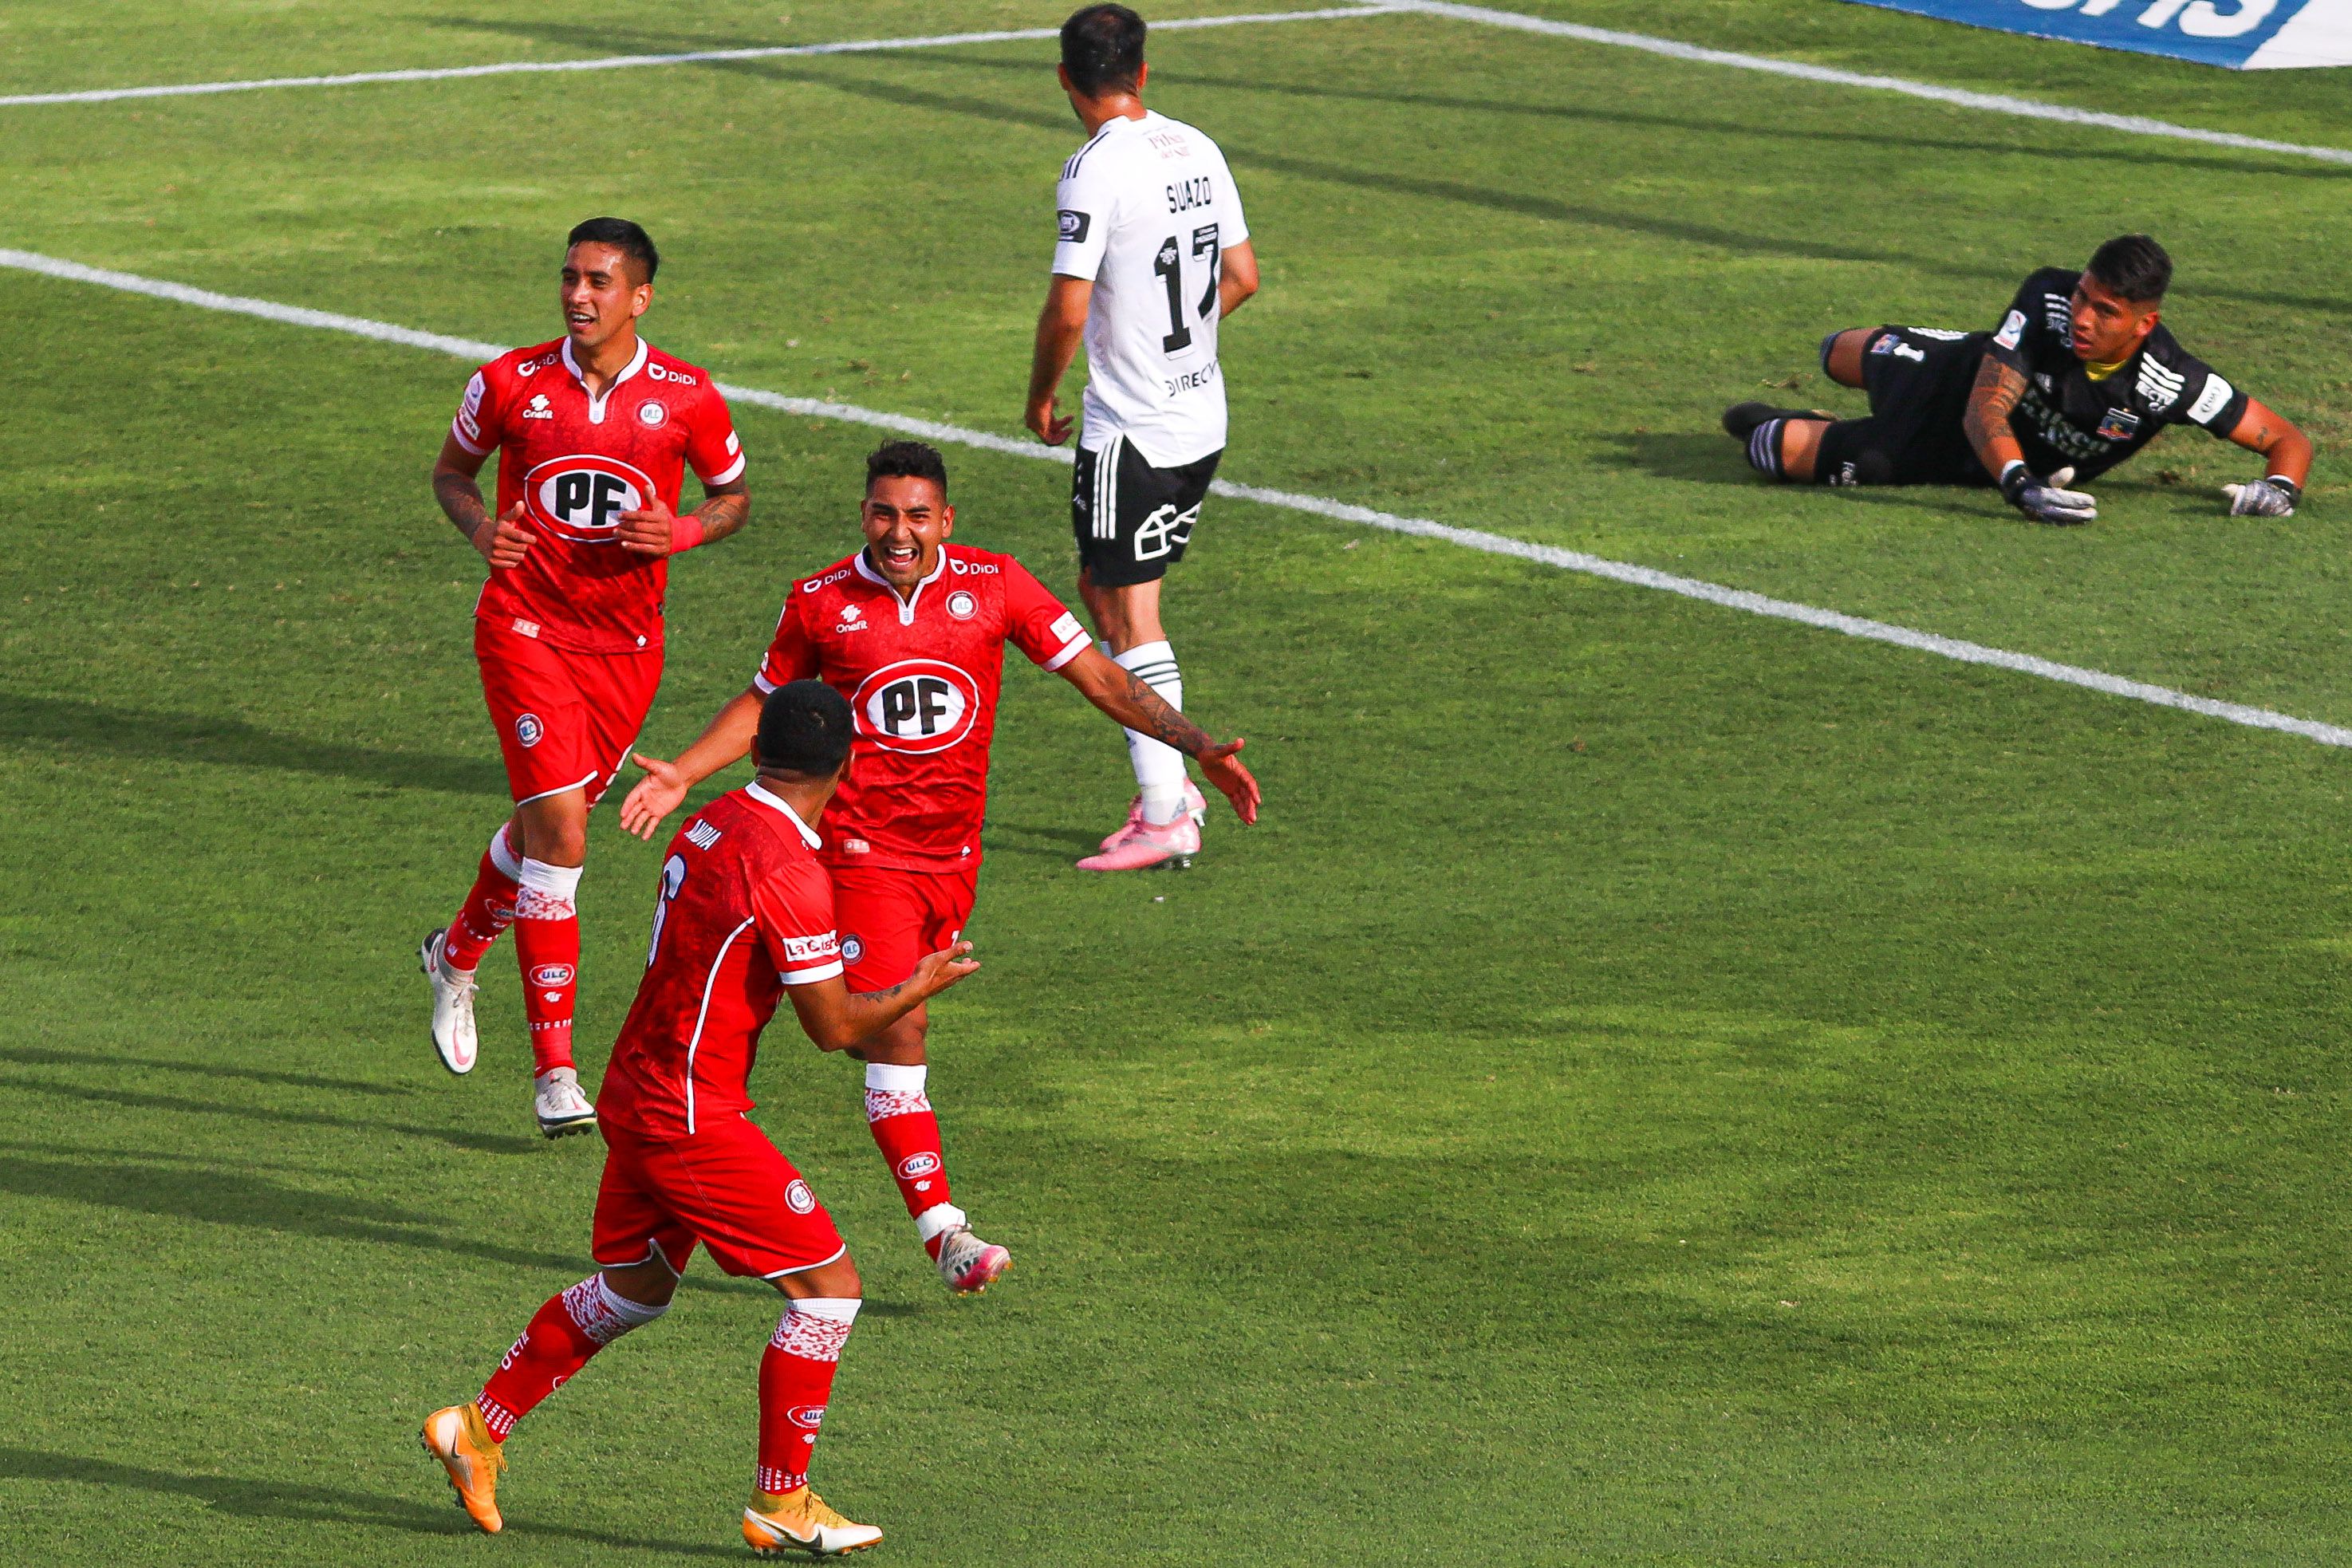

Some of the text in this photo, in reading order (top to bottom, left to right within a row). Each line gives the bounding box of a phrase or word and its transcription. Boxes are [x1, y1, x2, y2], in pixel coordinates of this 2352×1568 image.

[1166, 176, 1211, 214] SUAZO
[1153, 222, 1219, 354] 17
[668, 371, 697, 387] DiDi
[555, 472, 627, 526] PF
[970, 562, 999, 575] DiDi
[836, 620, 869, 634] Onefit
[881, 677, 948, 735] PF
[786, 944, 806, 956] La
[542, 970, 567, 979] ULC
[907, 1158, 931, 1172] ULC
